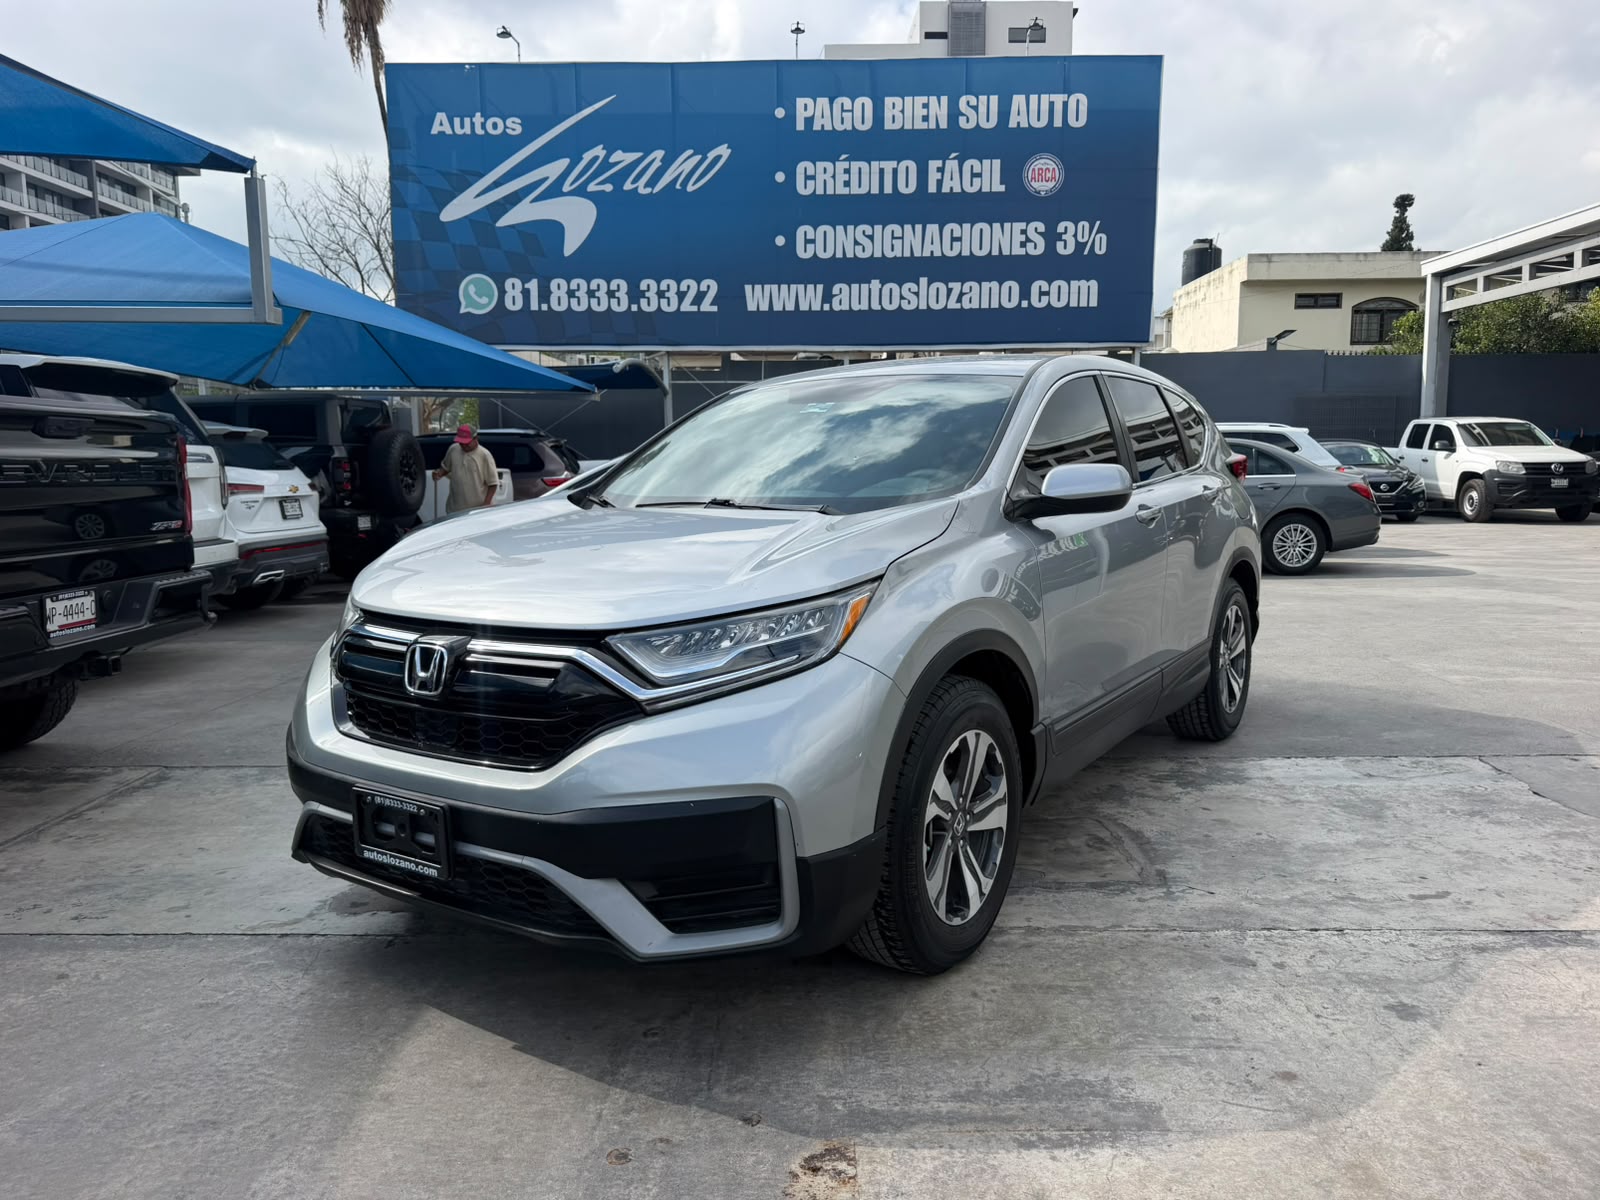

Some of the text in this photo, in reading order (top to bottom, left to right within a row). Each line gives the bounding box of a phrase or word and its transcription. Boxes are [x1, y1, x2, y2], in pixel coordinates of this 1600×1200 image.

[430, 111, 523, 135] Autos
[796, 93, 1088, 131] PAGO BIEN SU AUTO
[796, 152, 1006, 195] CRÉDITO FÁCIL
[1030, 167, 1057, 183] ARCA
[796, 220, 1108, 259] CONSIGNACIONES 3%
[504, 277, 719, 313] 81.8333.3322
[744, 277, 1099, 312] www.autoslozano.com
[363, 849, 438, 877] autoslozano.com
